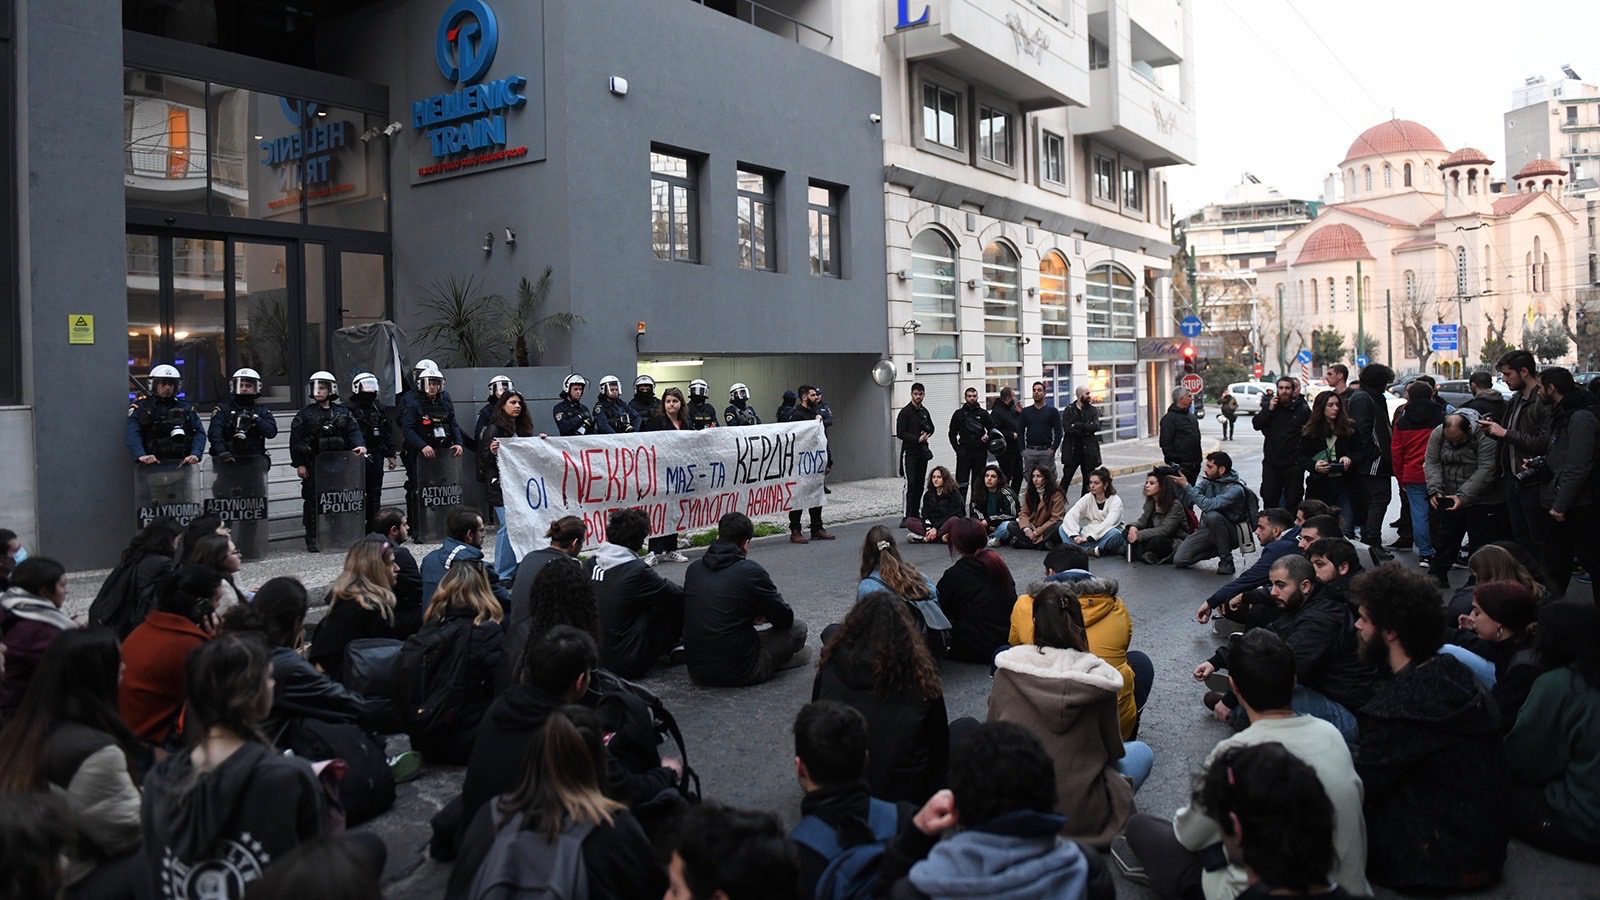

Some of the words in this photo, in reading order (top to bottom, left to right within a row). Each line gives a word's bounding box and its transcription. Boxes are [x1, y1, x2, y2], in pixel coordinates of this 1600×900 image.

[411, 76, 527, 129] HELLENIC
[427, 115, 507, 157] TRAIN
[1183, 379, 1201, 390] STOP
[526, 476, 549, 510] ΟΙ
[561, 444, 657, 507] ΝΕΚΡΟΙ
[733, 432, 796, 485] ΚΕΡΔΗ
[798, 450, 826, 476] ΤΟΥΣ
[207, 497, 265, 512] ΑΣΤΥΝΟΜΙΑ
[424, 495, 462, 507] POLICE
[745, 481, 797, 517] ΑΘΗΝΑΣ
[322, 500, 363, 514] POLICE
[214, 508, 263, 522] OLICE
